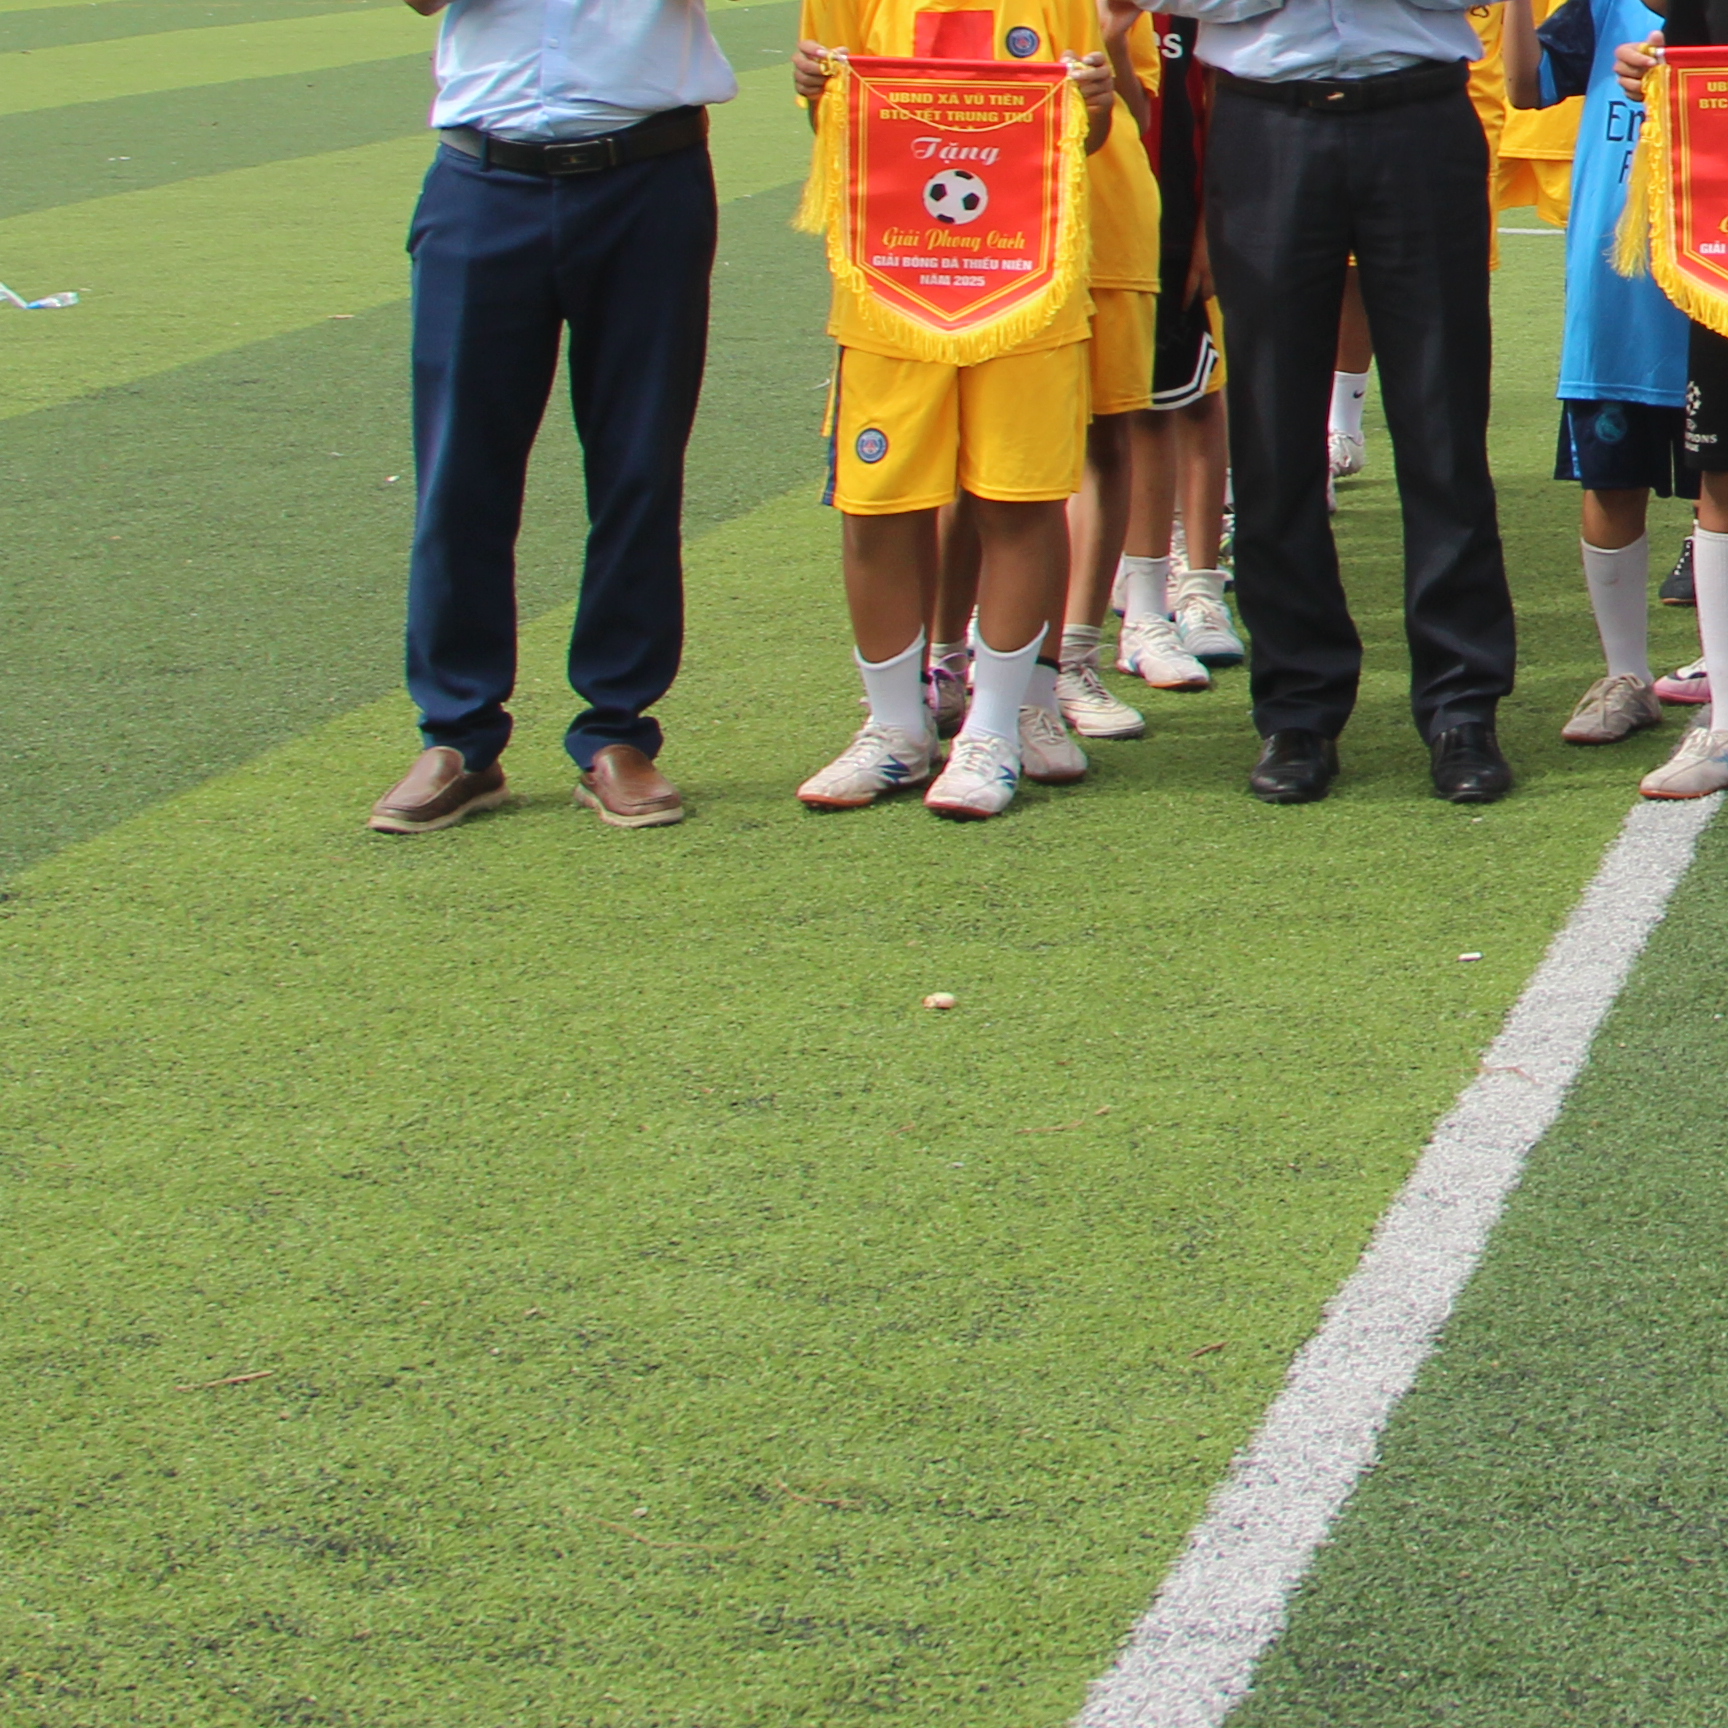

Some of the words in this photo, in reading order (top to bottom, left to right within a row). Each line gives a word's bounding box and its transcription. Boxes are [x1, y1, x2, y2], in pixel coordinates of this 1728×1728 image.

[889, 92, 933, 104] UBND
[1699, 98, 1728, 109] BTC
[880, 109, 911, 120] BTC
[947, 111, 998, 122] TRUNG
[1003, 112, 1033, 122] THU
[911, 136, 1001, 165] Tặng
[925, 228, 981, 251] Phong
[953, 275, 985, 286] 2025
